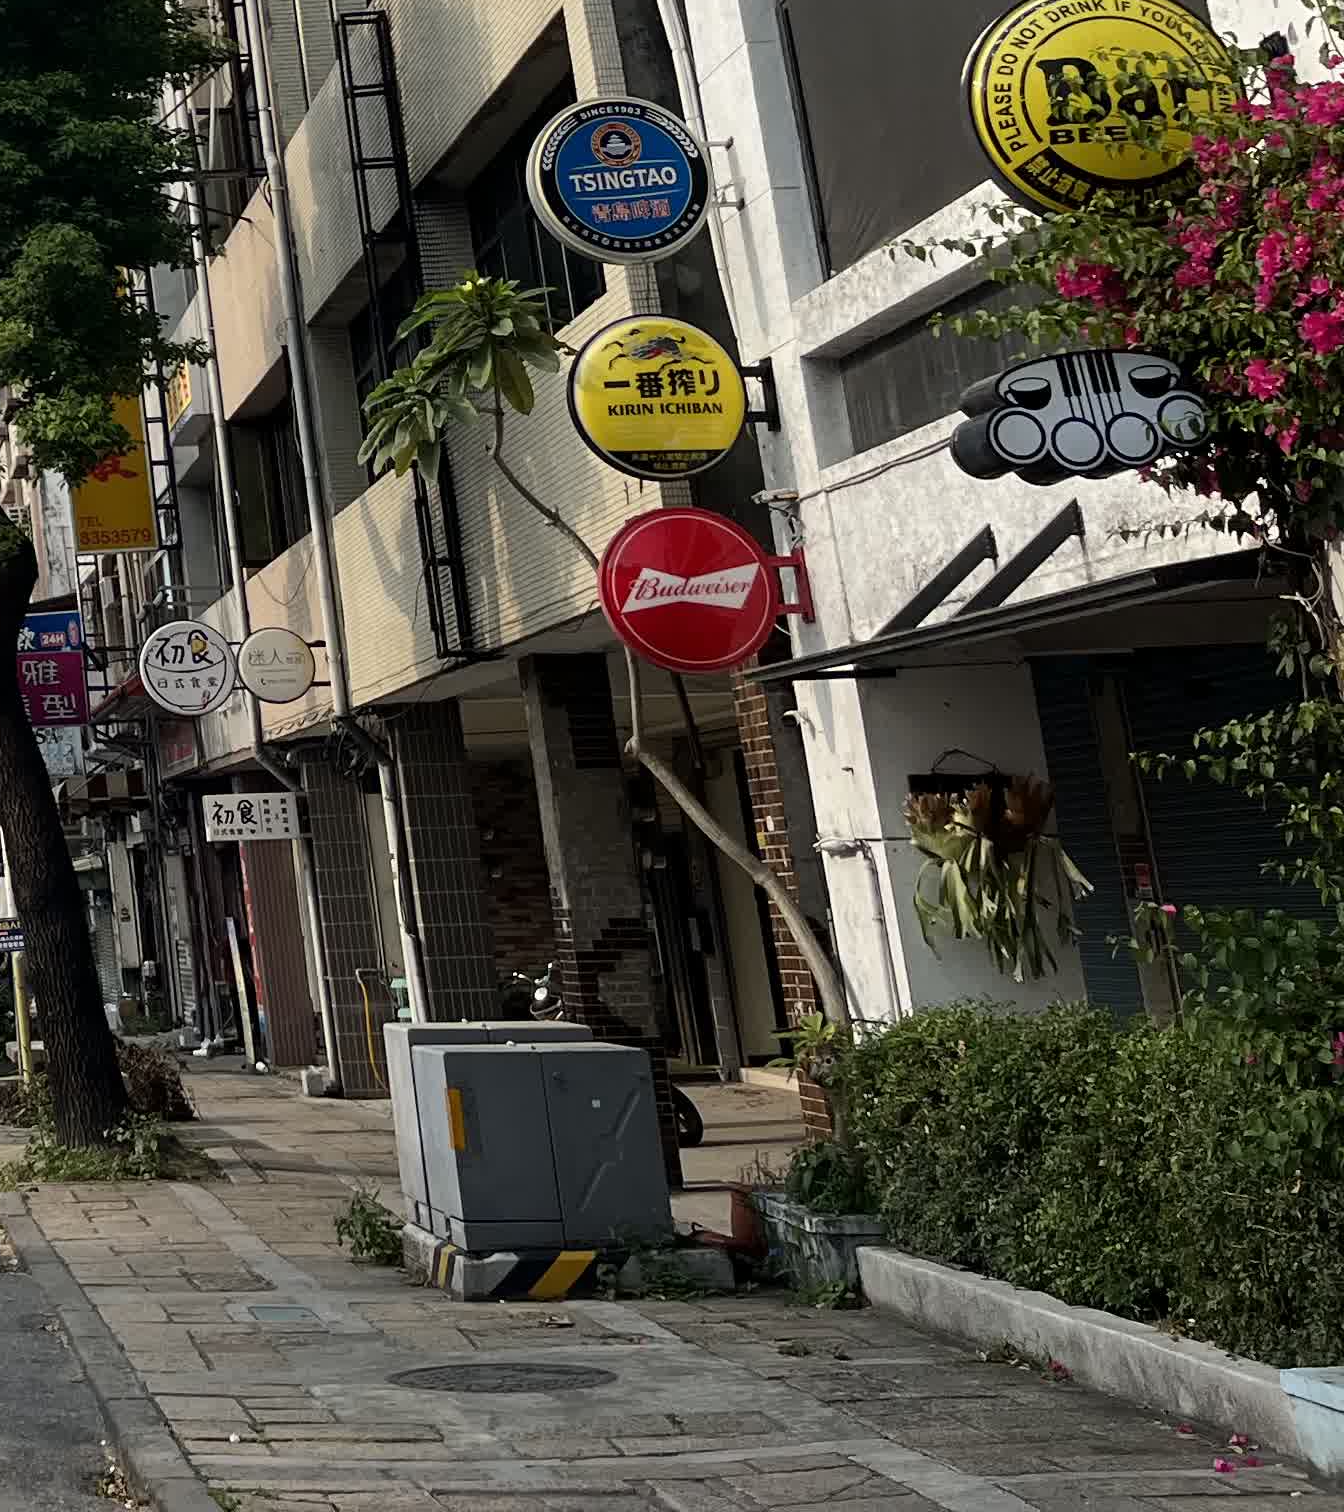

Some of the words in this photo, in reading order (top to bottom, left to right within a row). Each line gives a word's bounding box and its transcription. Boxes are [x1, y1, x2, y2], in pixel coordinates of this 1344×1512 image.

[1044, 0, 1108, 24] DRINK
[1115, 0, 1132, 12] IF
[1140, 5, 1179, 29] YOU
[1012, 20, 1045, 50] NOT
[996, 53, 1019, 76] DO
[994, 82, 1029, 153] PLEASE
[568, 166, 678, 193] TSINGTAO
[603, 368, 720, 399] 一番搾り
[608, 403, 654, 417] KIRIN
[660, 402, 724, 415] ICHIBAN
[79, 515, 103, 528] TEL
[78, 528, 153, 546] 8353579
[628, 576, 752, 601] Budweiser
[41, 633, 65, 647] 24H
[154, 629, 215, 667] 初食
[212, 799, 258, 826] 初食
